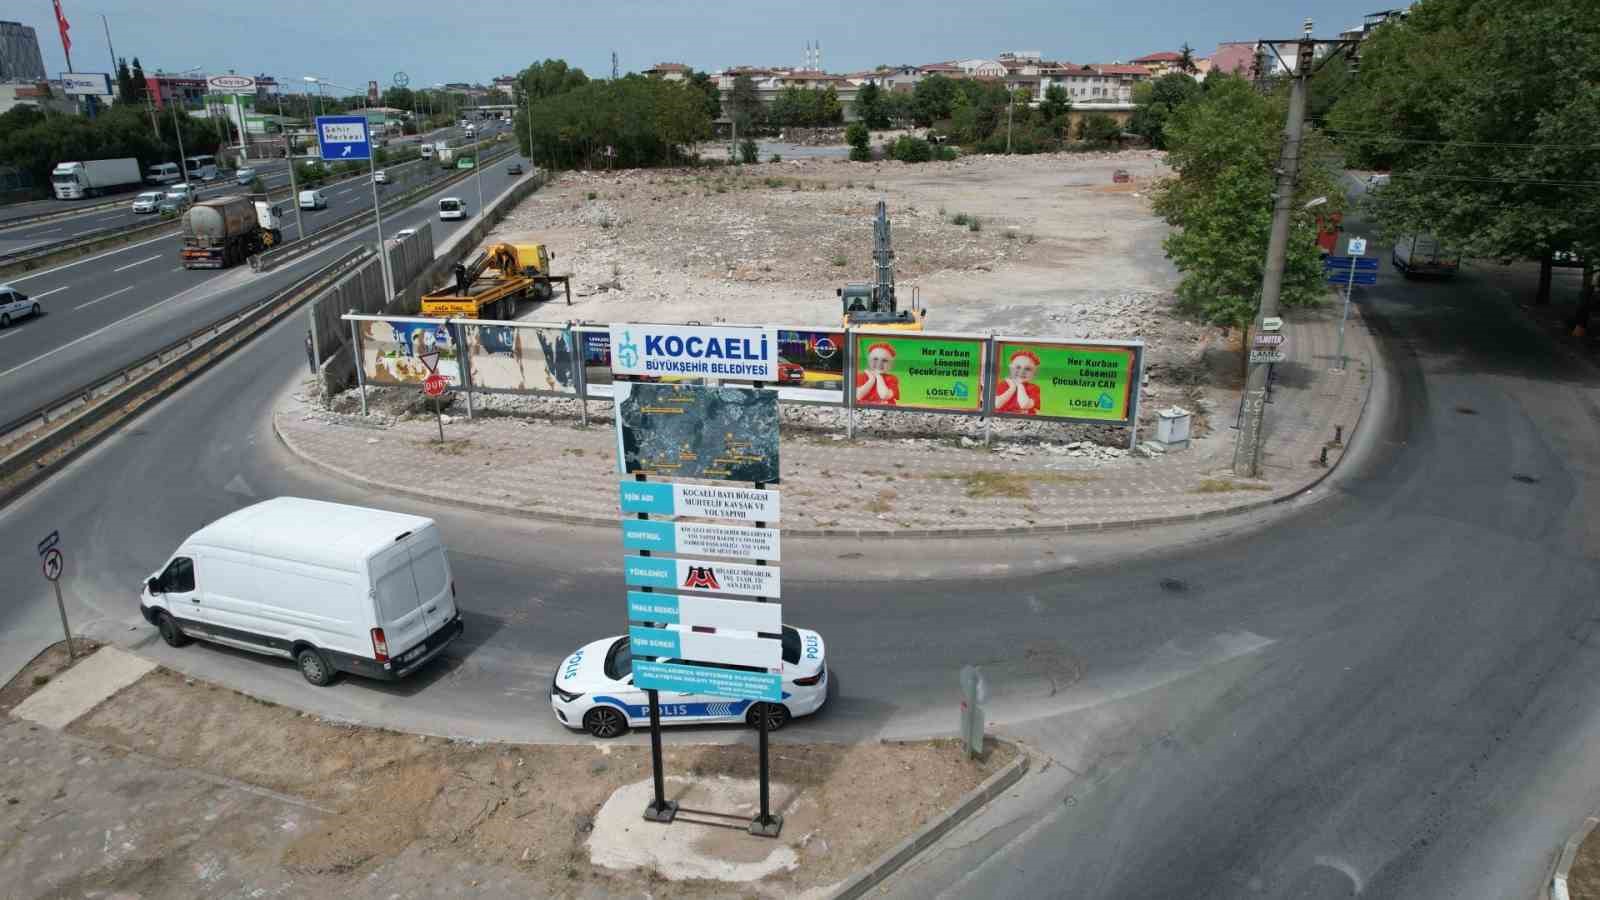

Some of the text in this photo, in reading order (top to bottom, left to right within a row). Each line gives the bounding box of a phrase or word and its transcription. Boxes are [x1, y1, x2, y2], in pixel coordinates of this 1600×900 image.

[645, 334, 768, 360] KOCAELİ
[646, 360, 768, 376] BÜYÜKŞEHİR BELEDİYESİ
[641, 705, 688, 717] PLIS
